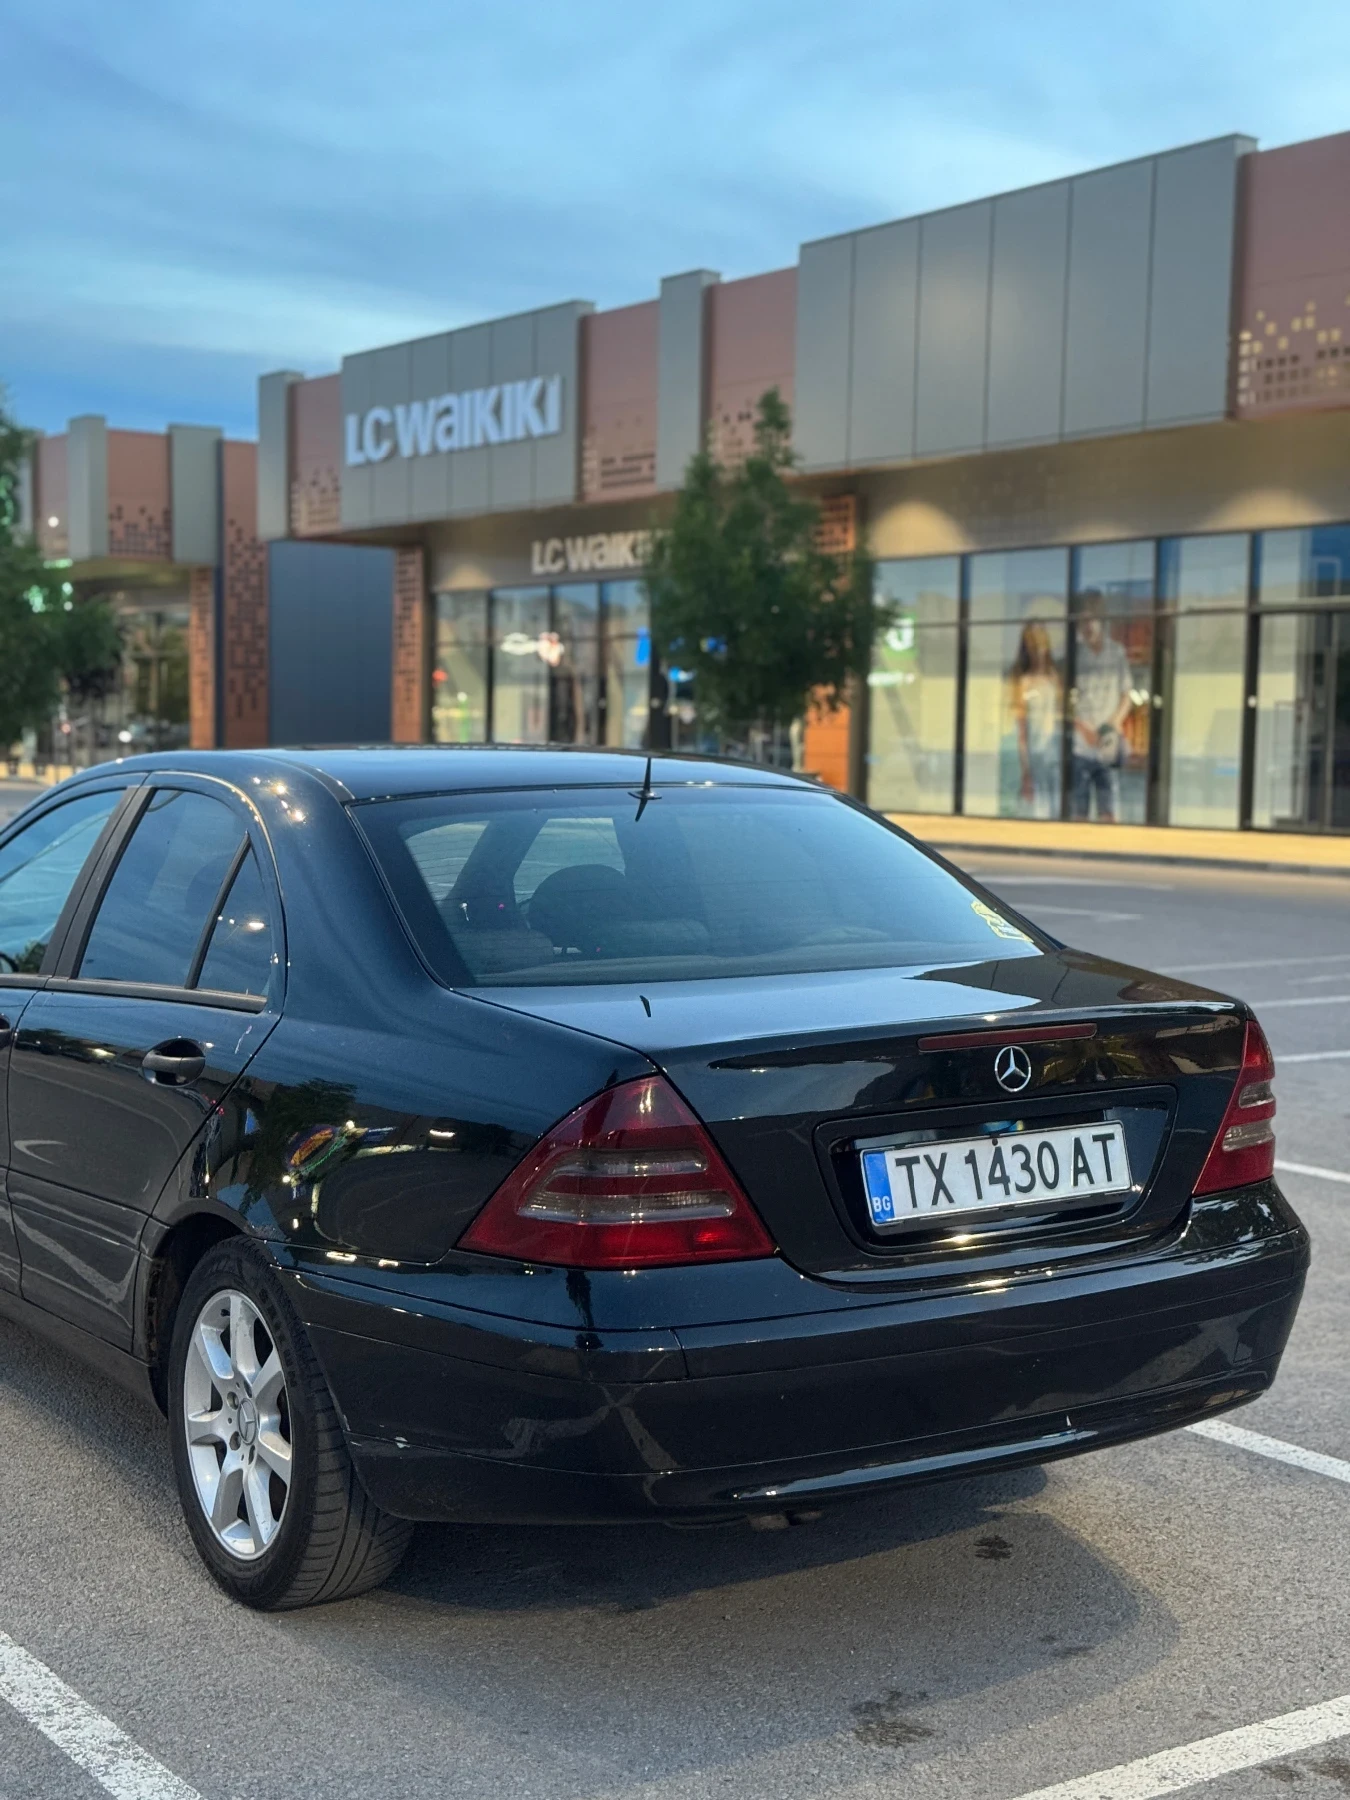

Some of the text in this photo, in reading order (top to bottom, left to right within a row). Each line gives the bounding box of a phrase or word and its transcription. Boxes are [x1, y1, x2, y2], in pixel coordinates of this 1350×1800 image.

[895, 1133, 1115, 1208] TX 1430 AT
[872, 1196, 891, 1212] BG
